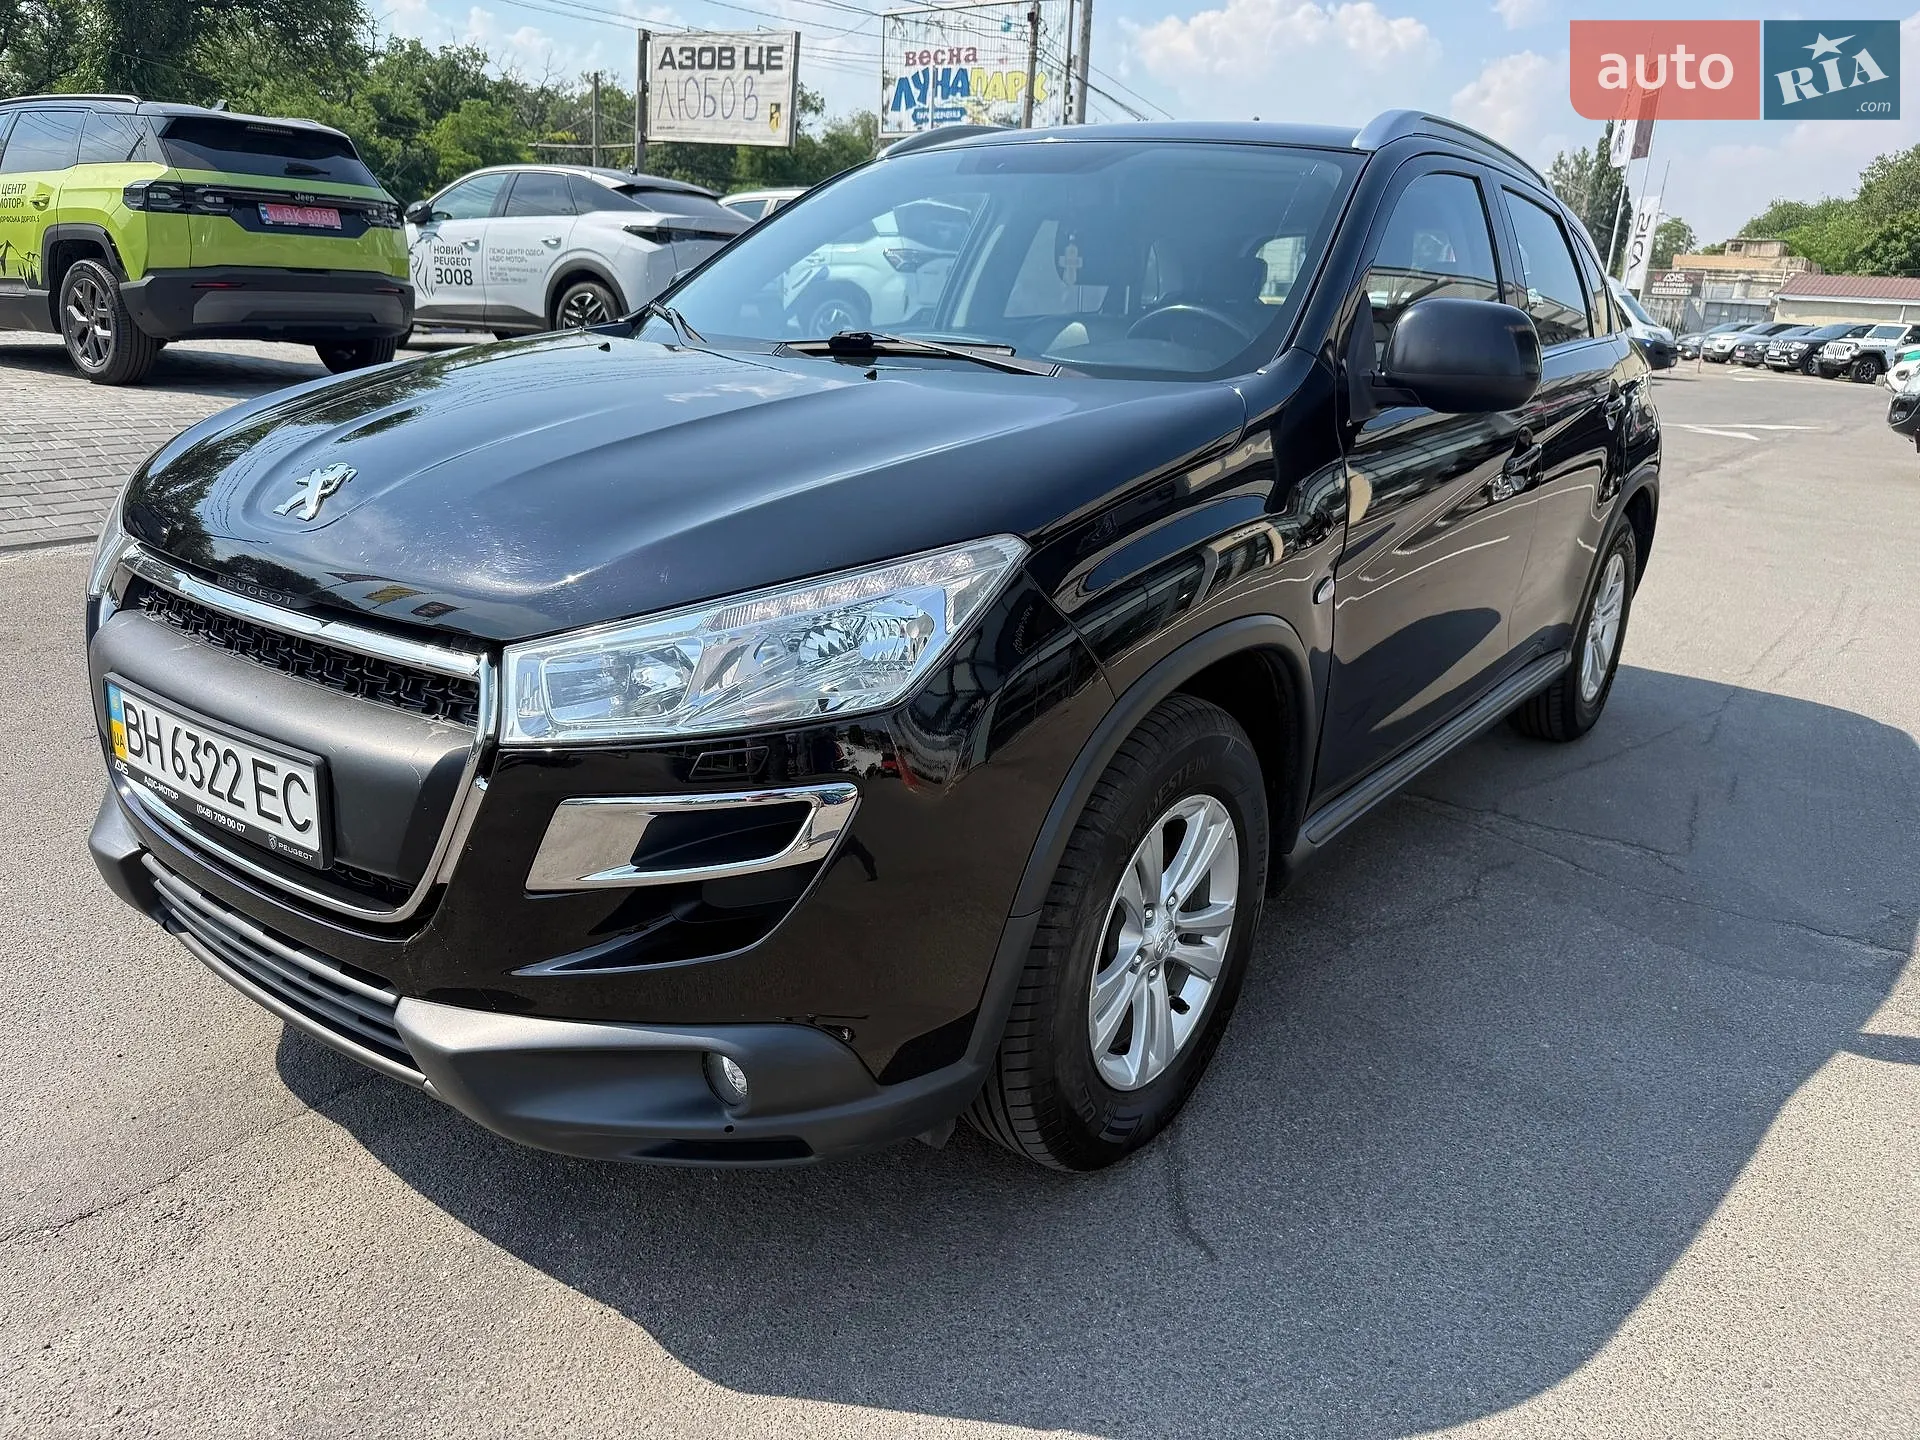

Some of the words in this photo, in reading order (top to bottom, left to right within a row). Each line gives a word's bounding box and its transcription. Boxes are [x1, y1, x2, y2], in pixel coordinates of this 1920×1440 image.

[658, 46, 736, 70] АЗОВ
[744, 46, 784, 75] ЦЕ
[904, 46, 978, 67] весна
[657, 75, 759, 121] ЛЮБОВ
[1, 184, 27, 196] ЦЕНТР
[295, 193, 315, 203] Jeep
[433, 245, 464, 256] НОВИЙ
[433, 256, 472, 267] PEUGEOT
[435, 267, 474, 286] 3008
[216, 575, 296, 605] PEUGEOT
[113, 731, 126, 750] UA
[123, 700, 166, 772] BH
[171, 726, 246, 809] 6322
[251, 757, 312, 834] EC
[196, 803, 213, 820] (048)
[213, 812, 227, 826] 709
[227, 817, 236, 829] 00
[237, 822, 247, 833] 07
[278, 842, 313, 861] PEUGEOT
